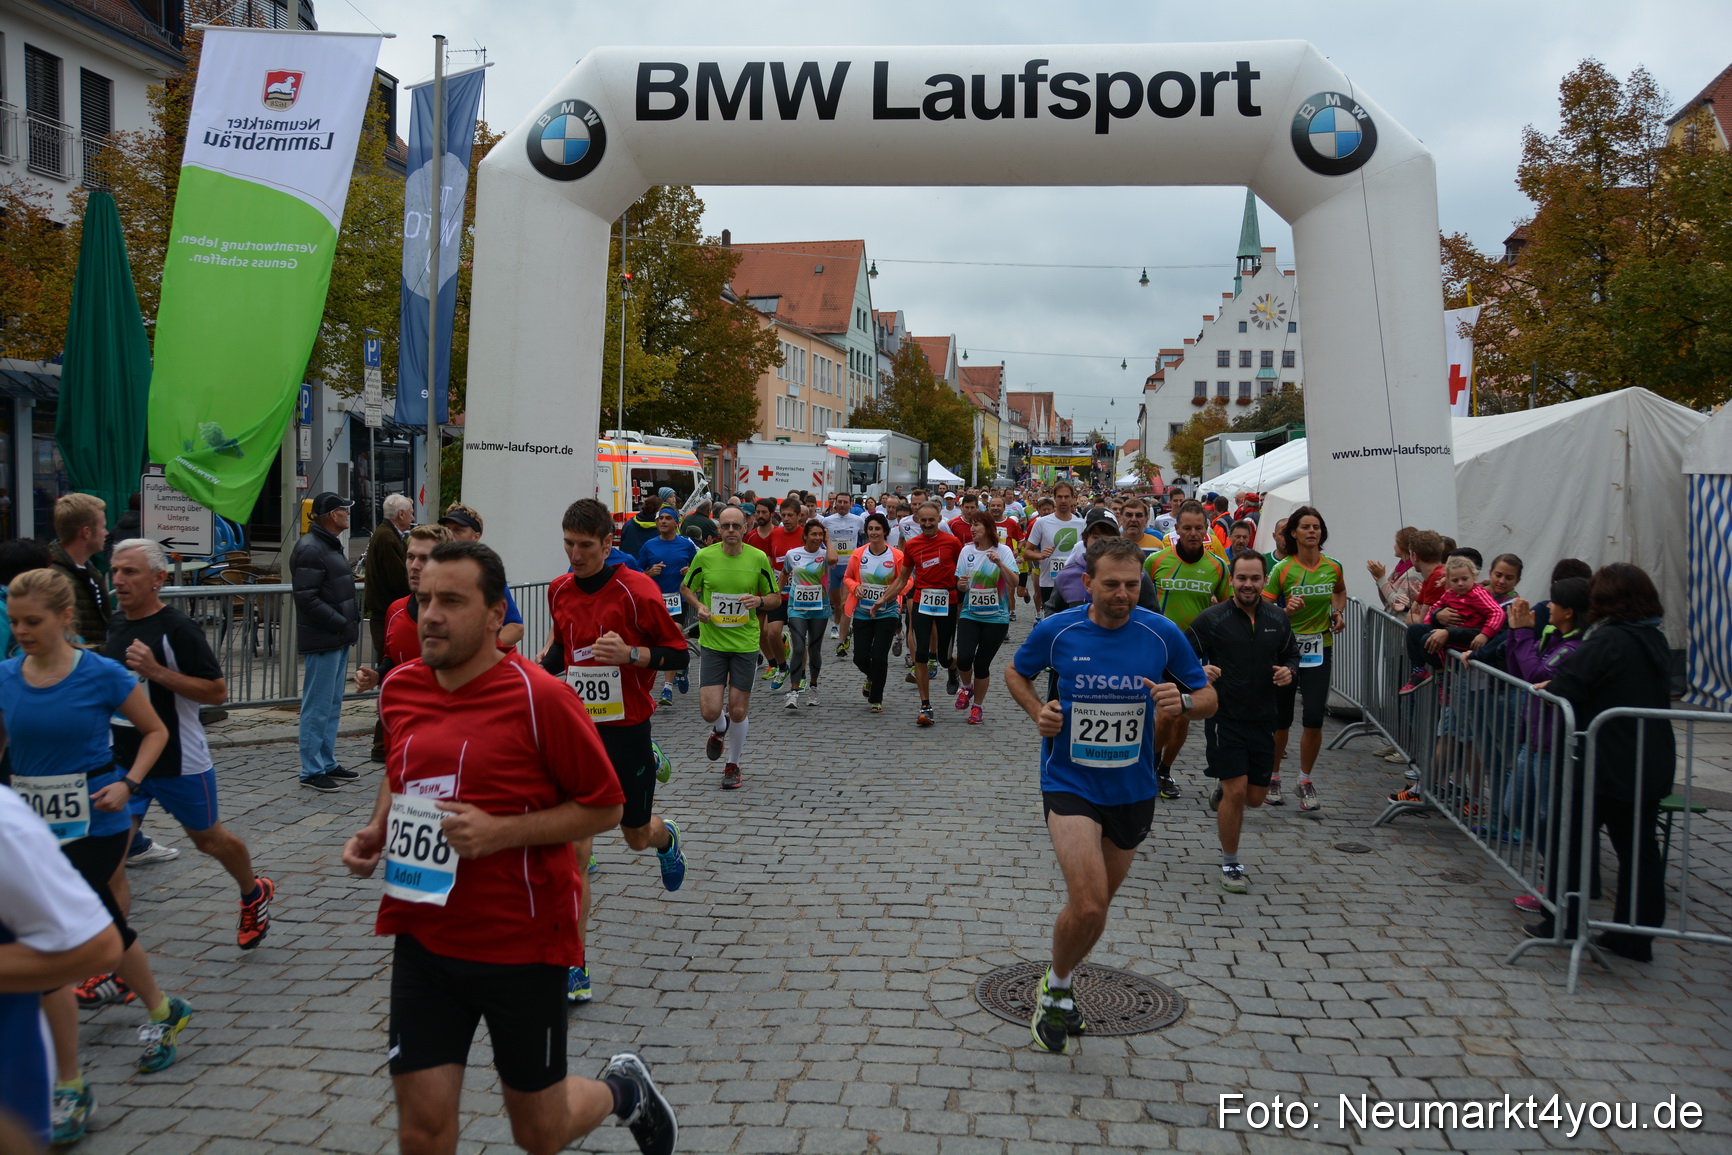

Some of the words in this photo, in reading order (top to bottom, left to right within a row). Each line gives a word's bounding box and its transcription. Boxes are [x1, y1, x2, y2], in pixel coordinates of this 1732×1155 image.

[635, 60, 851, 121] BMW
[872, 58, 1262, 135] Laufsport
[537, 101, 600, 128] BMW
[367, 338, 377, 362] P
[302, 389, 310, 420] P
[326, 438, 333, 452] 3
[465, 440, 574, 455] www.bmw-laufsport.de
[1331, 443, 1451, 460] www.bmw-laufsport.de
[145, 483, 180, 493] Fußgäng
[154, 503, 186, 513] Kreuzung
[187, 504, 203, 512] über
[167, 513, 190, 522] Untere
[157, 523, 200, 533] Kaserngasse
[837, 542, 847, 550] 80
[1161, 578, 1213, 594] BOCK
[1291, 583, 1335, 597] BOCK
[796, 590, 820, 601] 2637
[923, 594, 946, 606] 2168
[971, 594, 996, 605] 2456
[718, 601, 742, 614] 217
[581, 649, 593, 657] DEH
[1075, 674, 1146, 690] SYSCAD
[574, 680, 610, 701] 289
[584, 706, 607, 715] arkus
[1073, 707, 1098, 716] PARTL
[1099, 709, 1135, 717] Neumarkt
[1078, 718, 1139, 743] 2213
[1084, 747, 1130, 760] Wolfgang
[419, 783, 441, 795] DEHN
[389, 818, 450, 865] 2568
[393, 867, 422, 887] Adolf
